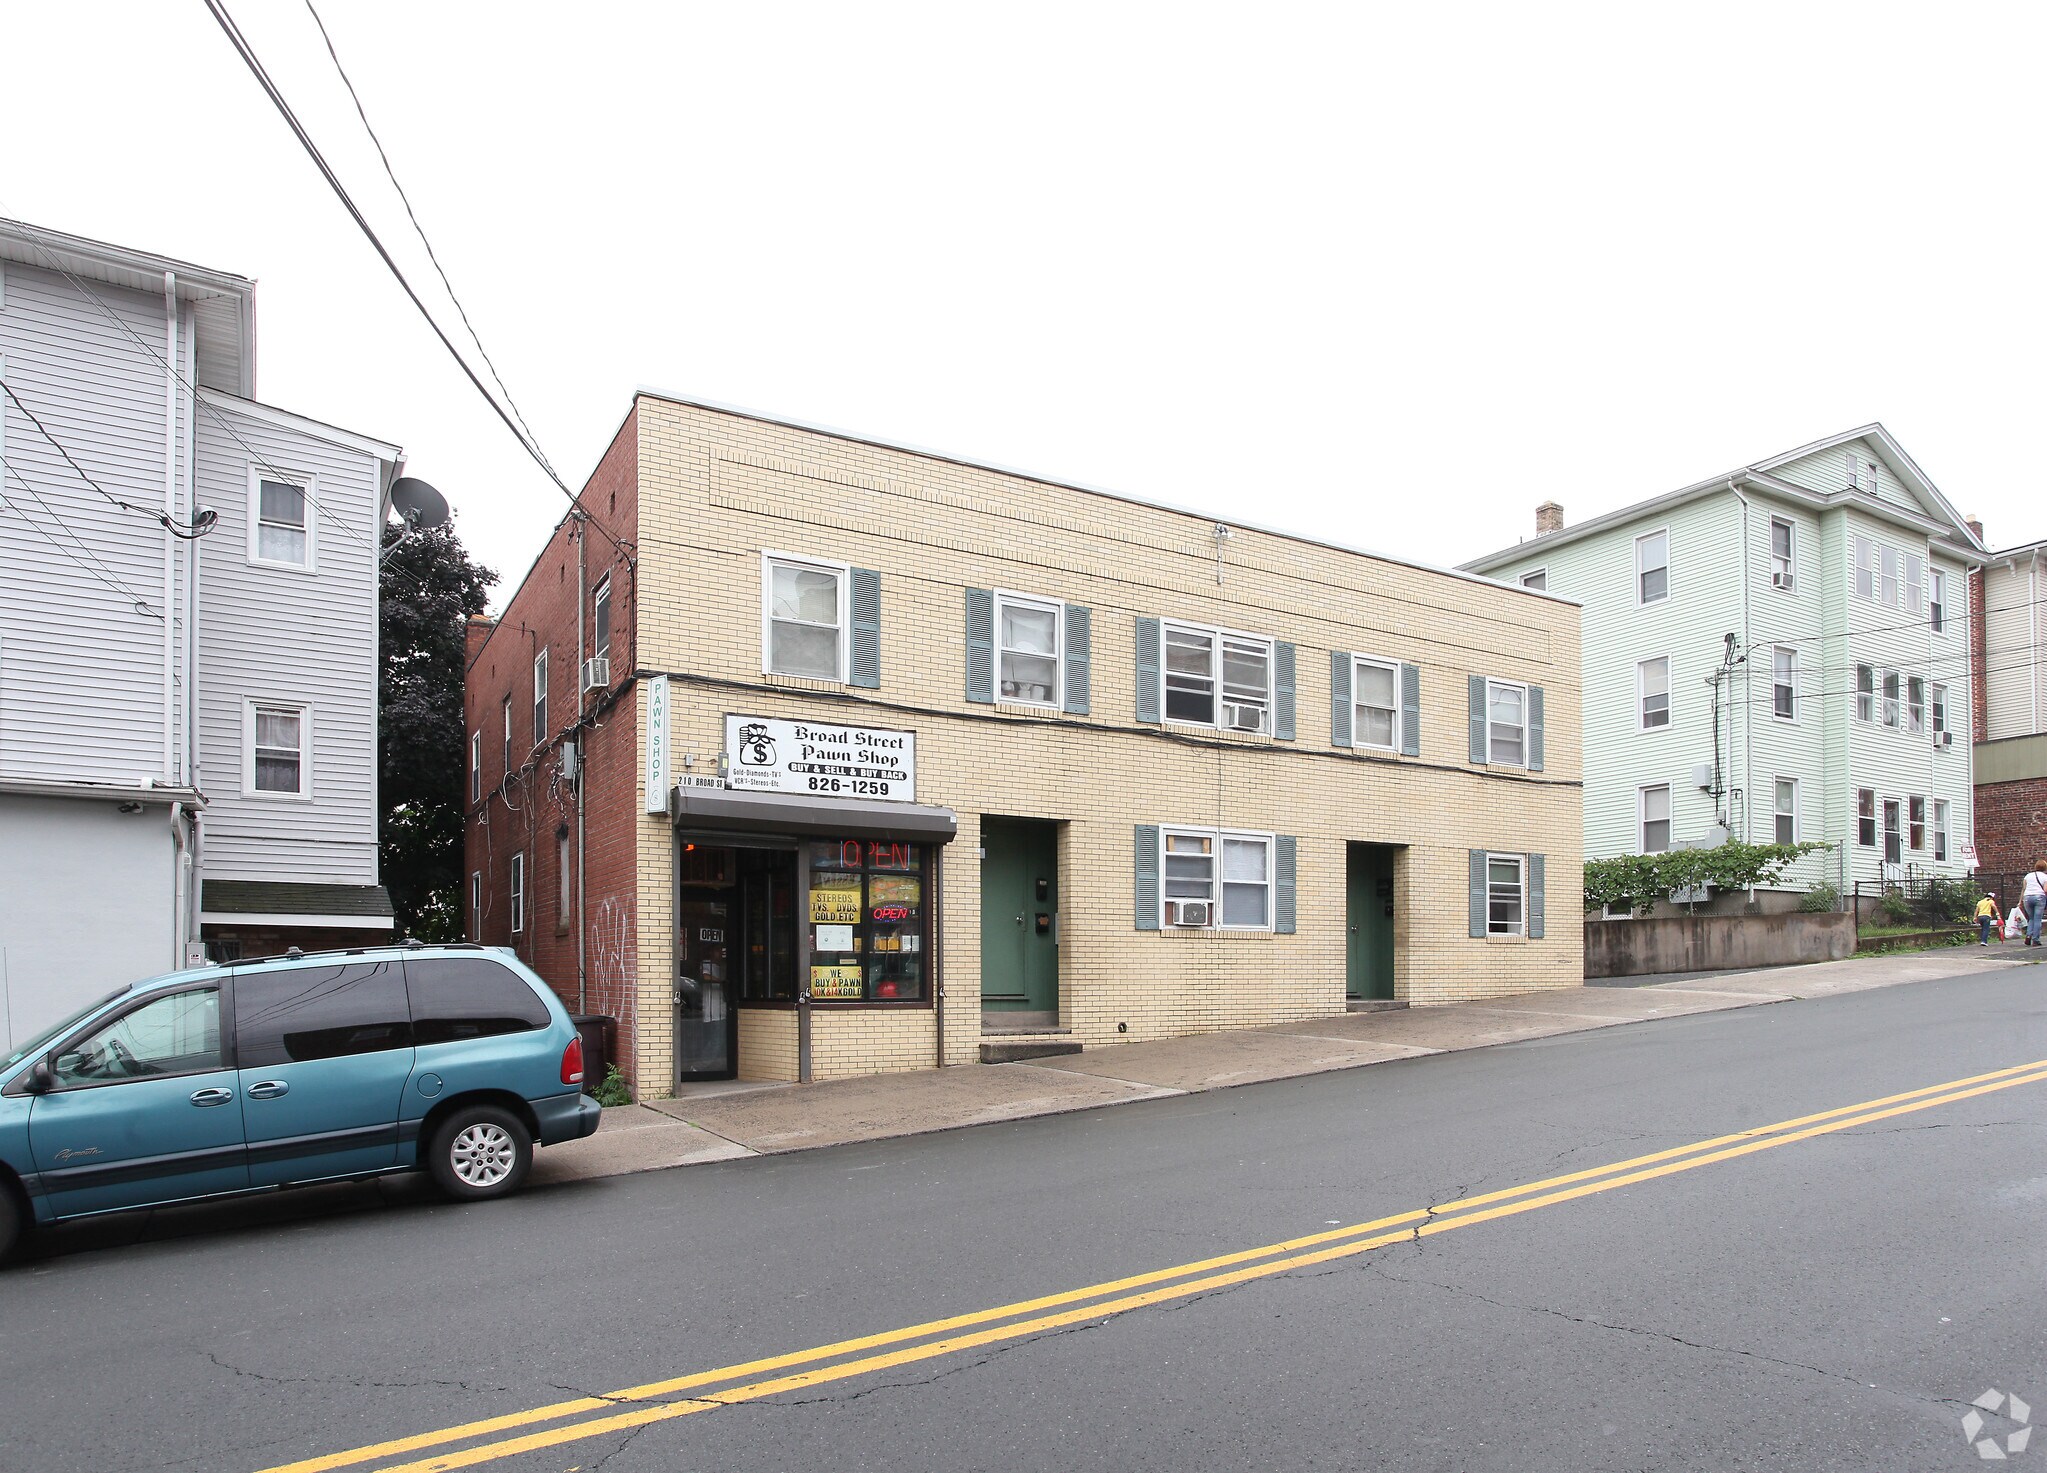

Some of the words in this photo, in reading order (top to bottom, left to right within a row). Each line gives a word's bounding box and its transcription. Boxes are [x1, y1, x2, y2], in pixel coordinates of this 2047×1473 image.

[653, 684, 662, 729] PAWN
[794, 726, 848, 743] Broad
[854, 732, 903, 749] Street
[801, 744, 851, 761] Pawn
[857, 750, 899, 768] Shop
[791, 763, 809, 772] BUY
[813, 765, 821, 773] &
[824, 766, 846, 775] SELL
[850, 767, 856, 776] &
[860, 768, 878, 777] BUY
[881, 771, 904, 780] BACK
[679, 776, 691, 785] 210
[695, 778, 714, 787] BROAD
[808, 777, 889, 796] 826-1259
[843, 840, 907, 869] OPEN
[816, 894, 852, 903] STEREOS
[873, 908, 908, 919] OPEN
[830, 969, 841, 978] WE
[815, 979, 830, 987] BUY
[832, 979, 837, 987] &
[839, 979, 861, 987] PAWN
